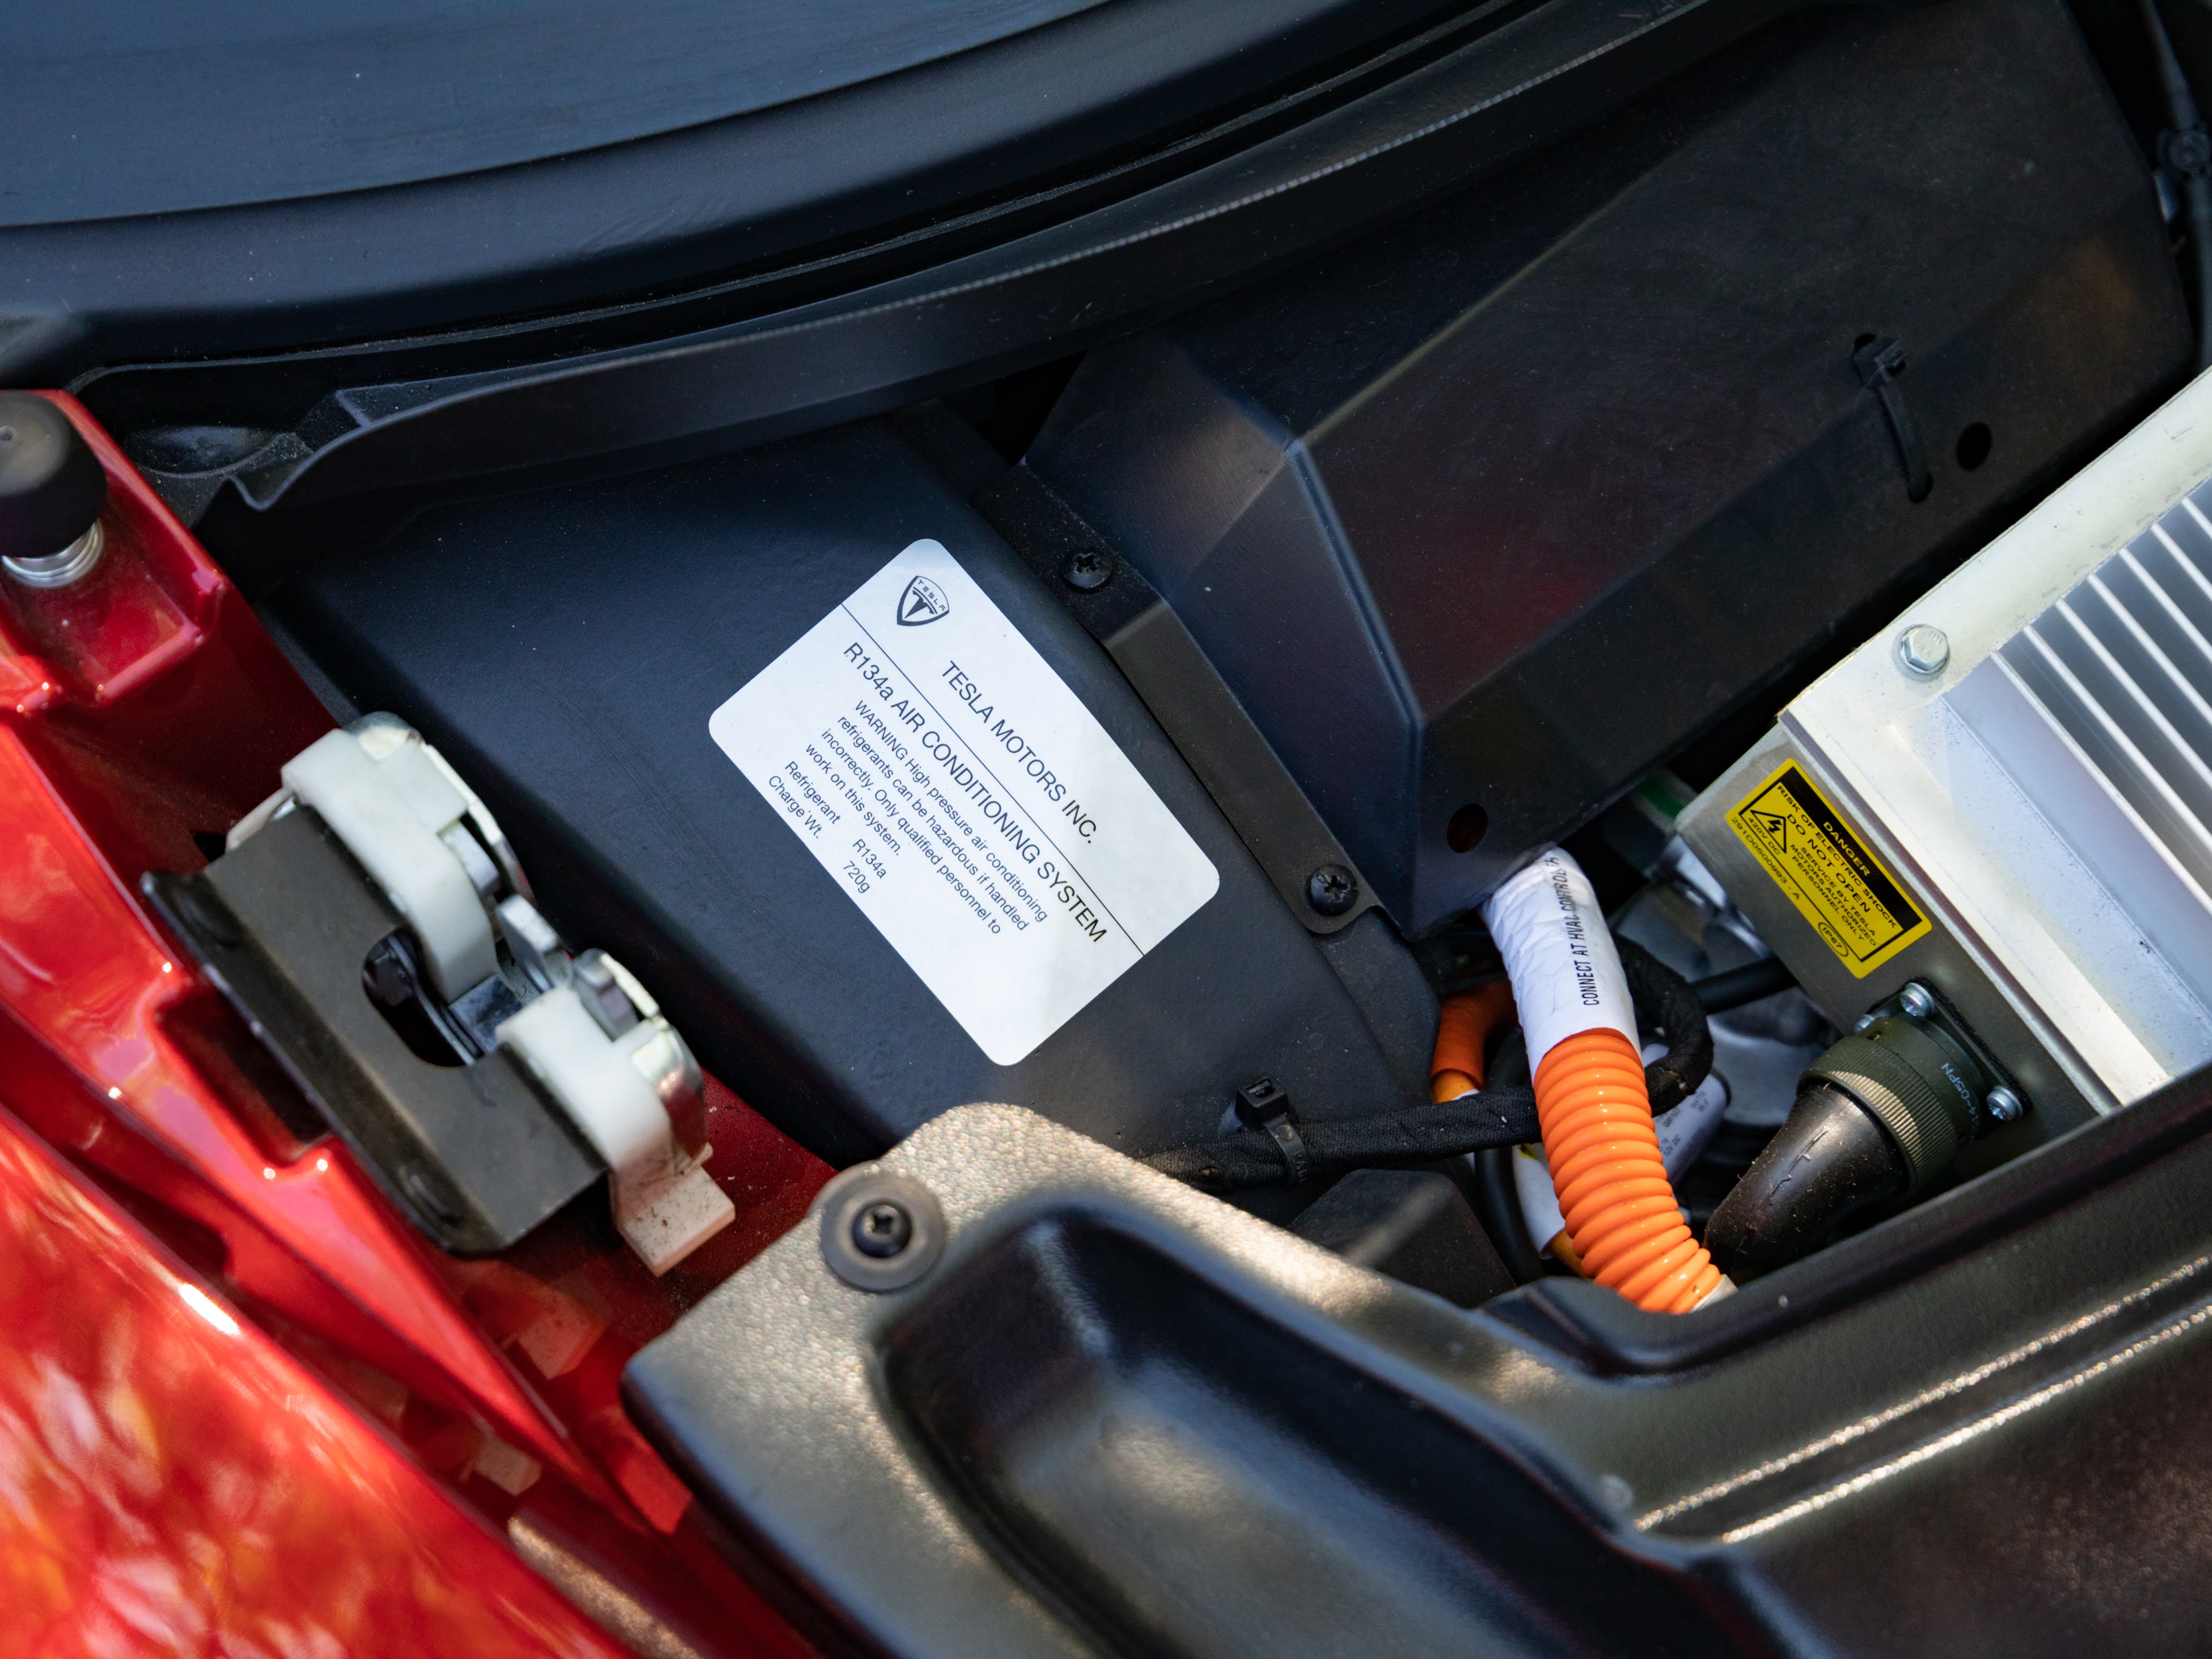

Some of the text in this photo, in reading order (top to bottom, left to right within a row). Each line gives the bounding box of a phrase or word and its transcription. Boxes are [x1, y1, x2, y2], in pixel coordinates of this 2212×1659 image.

[918, 579, 946, 612] TESLA
[806, 744, 901, 856] work on this system.
[843, 642, 1108, 943] R134a AIR CONDITIONING SYSTEM
[942, 660, 1096, 844] TESLA MOTORS INC.
[769, 776, 871, 894] Charge Wt. 720g
[784, 761, 886, 879] Refrigerant R134a
[821, 728, 1001, 934] incorrectly. Only qualified personnel to
[837, 716, 1030, 931] refrigerants can be hazardous if handled
[855, 699, 1048, 923] WARNING High pressure air conditioning
[1731, 817, 1787, 883] 291D0500993
[1749, 817, 1780, 855] 420V DC
[1777, 786, 1897, 928] RISK OF ELECTRIC SHOCK
[1823, 822, 1870, 876] DANGER
[1786, 814, 1871, 913] DO NOT OPEN
[1791, 844, 1876, 946] MOTORS AUTHORIZED
[1792, 856, 1864, 940] PERSONNEL ONLY
[1800, 847, 1875, 936] SERVICE BY TESLA
[1564, 915, 1585, 940] HVAC
[1570, 943, 1589, 956] AT
[1824, 927, 1843, 947] IP67
[1574, 960, 1599, 1006] CONNECT
